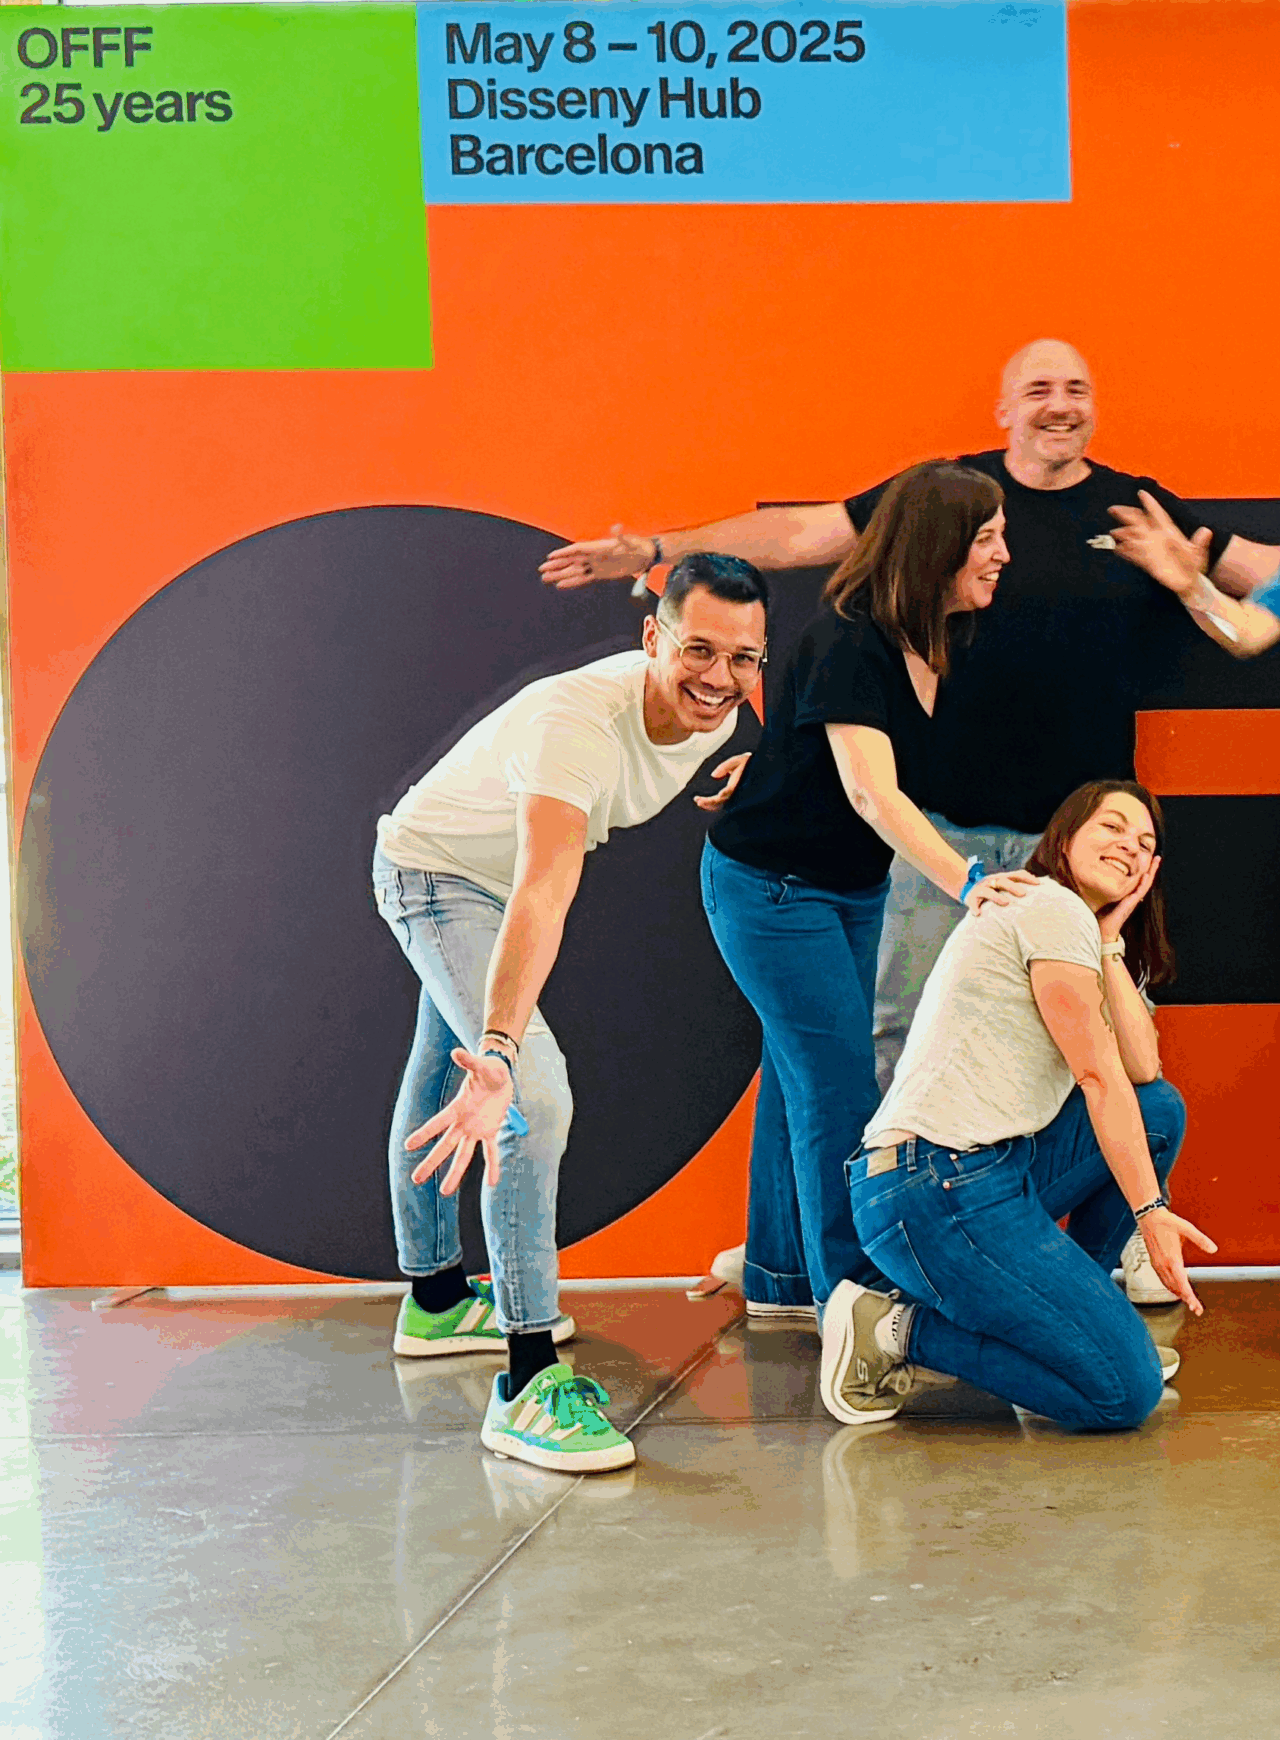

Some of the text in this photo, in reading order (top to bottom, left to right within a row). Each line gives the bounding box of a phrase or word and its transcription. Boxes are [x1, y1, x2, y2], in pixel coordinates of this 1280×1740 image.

[17, 27, 153, 69] OFFF
[445, 22, 554, 73] May
[563, 20, 597, 64] 8
[647, 21, 718, 69] 10,
[727, 20, 866, 63] 2025
[20, 82, 233, 132] 25 years
[447, 77, 762, 128] Disseny Hub
[450, 133, 704, 175] Barcelona
